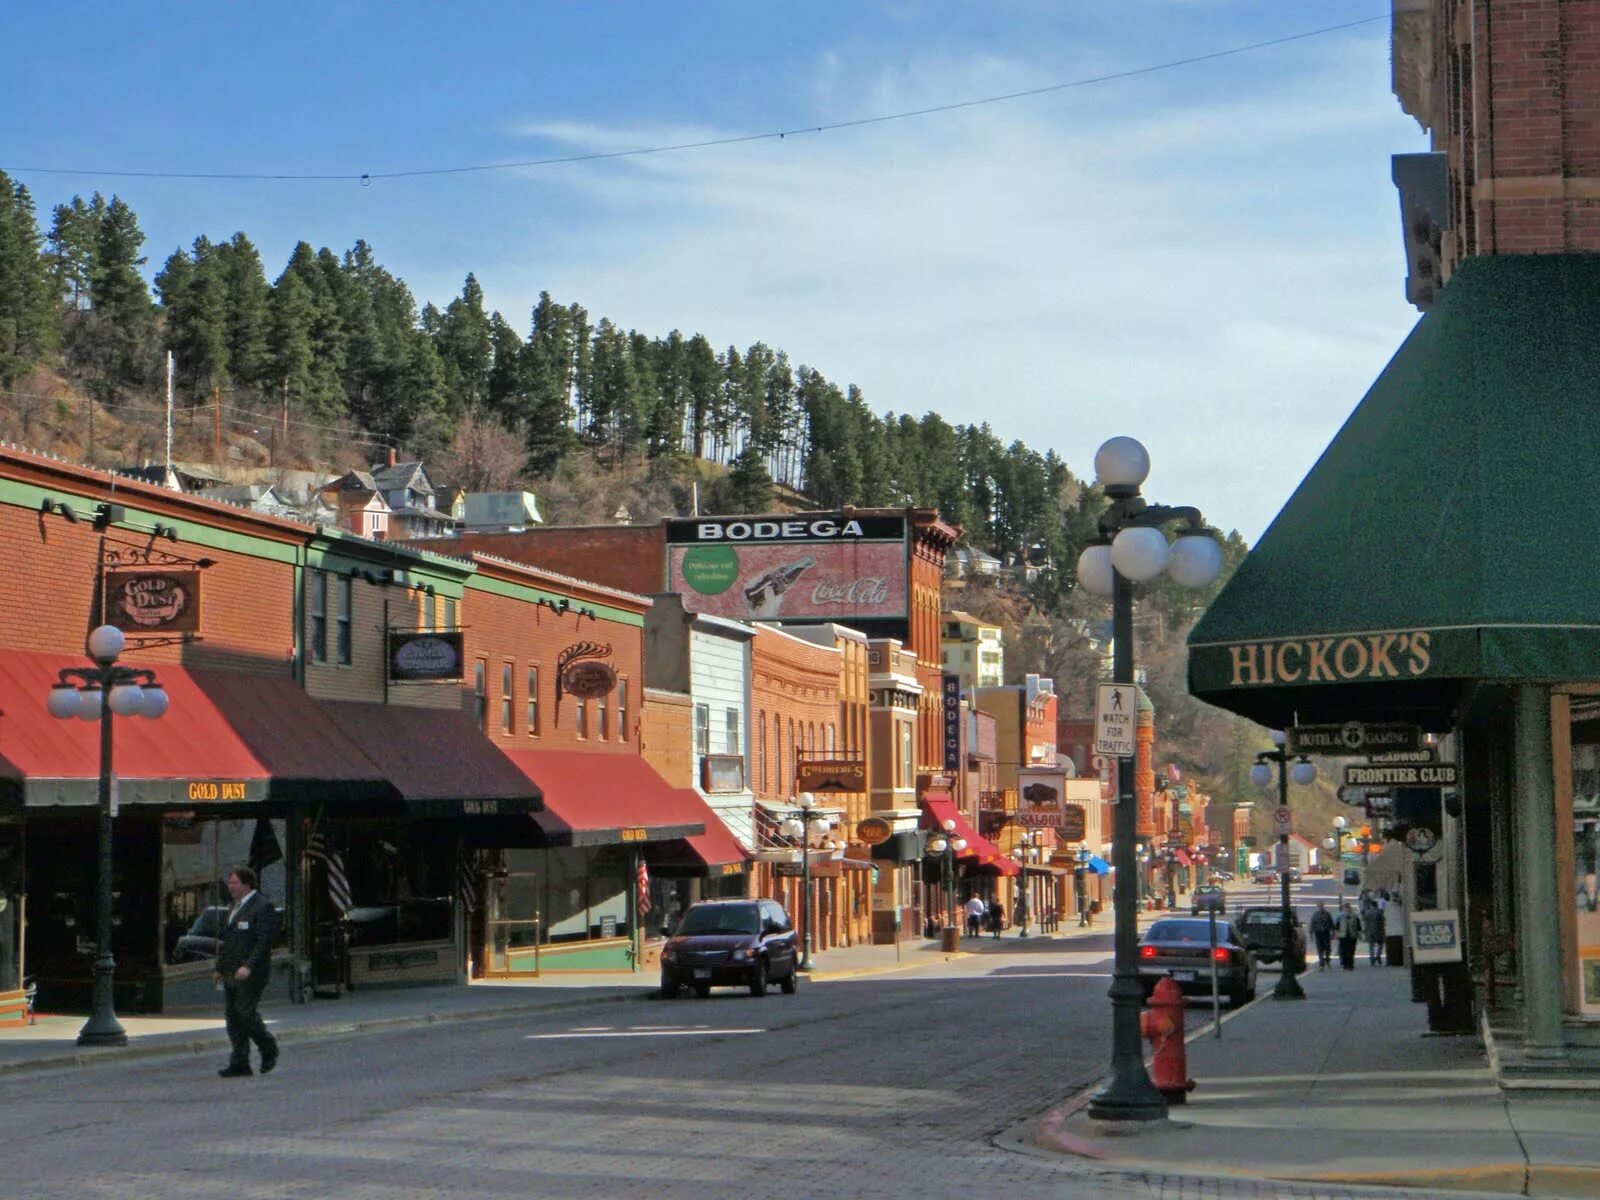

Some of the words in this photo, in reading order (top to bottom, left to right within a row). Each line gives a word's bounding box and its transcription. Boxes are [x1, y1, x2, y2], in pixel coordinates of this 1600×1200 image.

[697, 520, 864, 540] BODEGA
[1229, 630, 1431, 686] HICKOK'S
[947, 683, 957, 763] BODEGA
[1103, 713, 1130, 725] WATCH
[1106, 727, 1123, 738] FOR
[1300, 733, 1332, 746] HOTEL
[1364, 732, 1409, 745] GAMING
[1098, 740, 1131, 752] TRAFFIC
[1348, 768, 1417, 783] FRONTIER
[1420, 767, 1456, 782] CLUB
[189, 783, 218, 799] GOLD
[222, 783, 246, 799] DUST
[1020, 814, 1062, 826] SALOON
